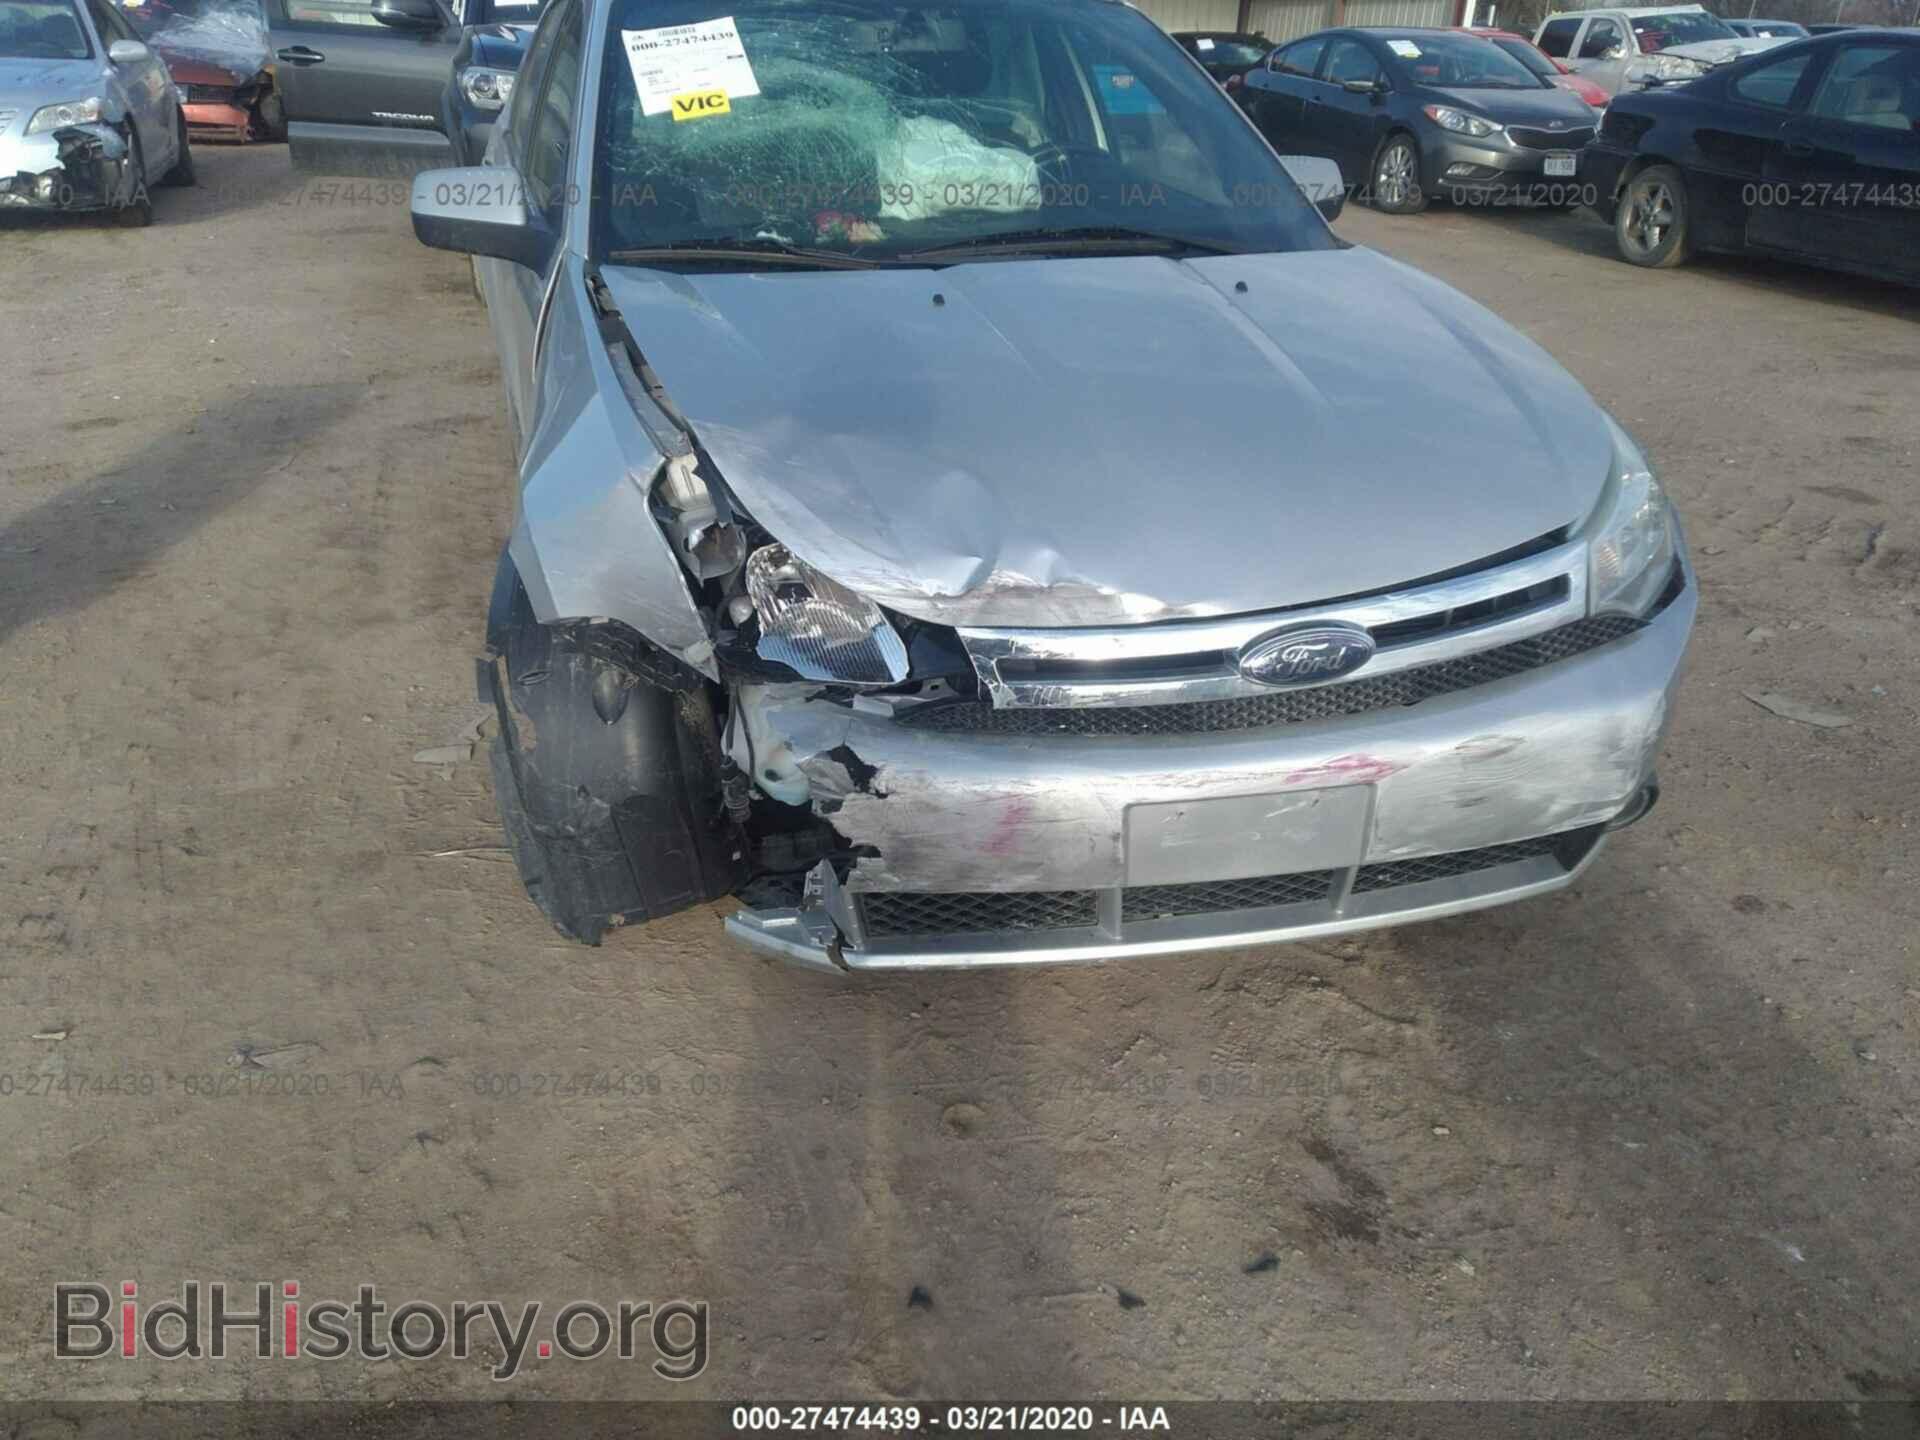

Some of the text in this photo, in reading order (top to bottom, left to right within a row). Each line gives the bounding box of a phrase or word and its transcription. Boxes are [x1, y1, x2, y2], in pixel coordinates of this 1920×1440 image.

[631, 32, 734, 52] 000-27474439
[676, 94, 725, 112] VIC
[1277, 642, 1346, 674] Ford
